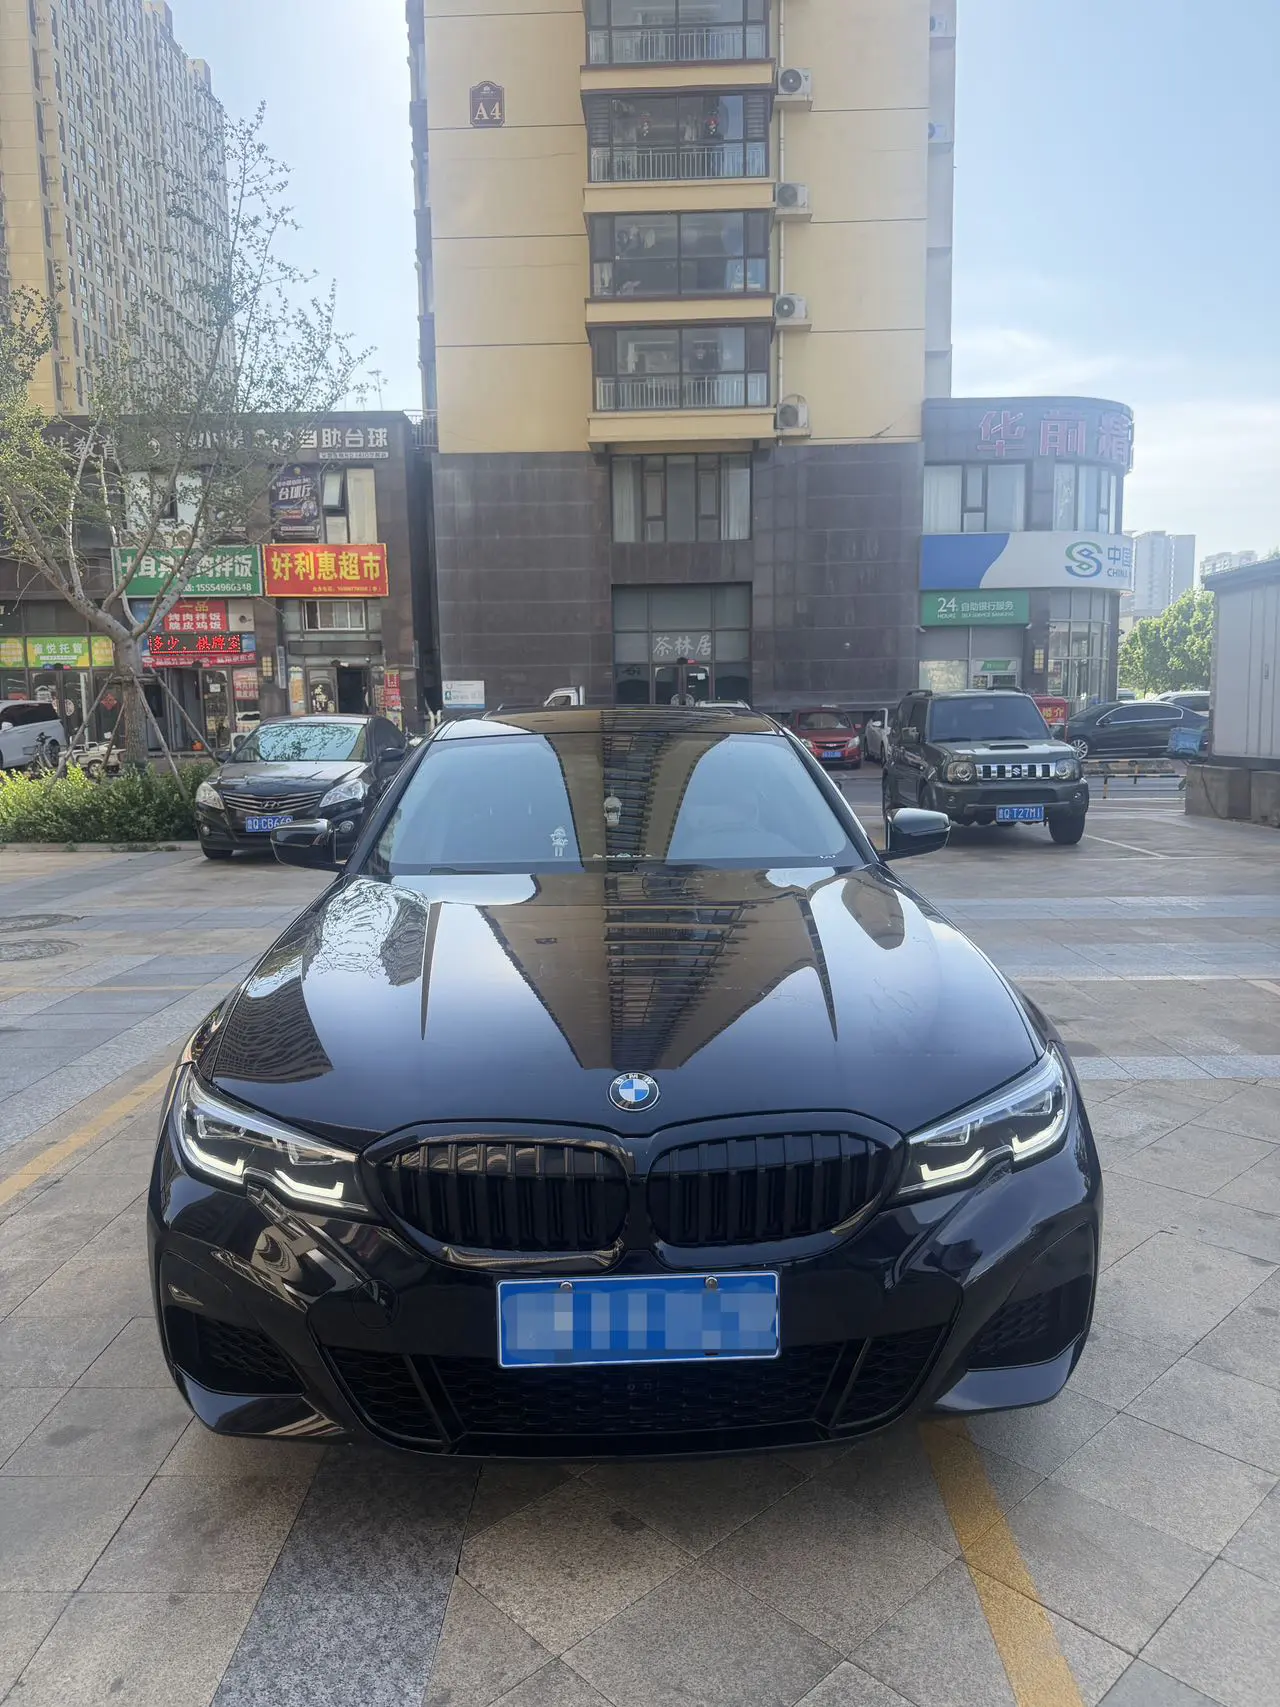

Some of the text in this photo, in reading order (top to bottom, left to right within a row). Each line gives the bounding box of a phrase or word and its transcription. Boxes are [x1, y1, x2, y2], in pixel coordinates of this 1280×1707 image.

[474, 101, 502, 120] A4
[119, 553, 253, 578] 土耳其肉拌饭
[271, 551, 381, 581] 好利惠超市
[936, 597, 957, 613] 24
[961, 601, 1014, 612] 自助银行服务
